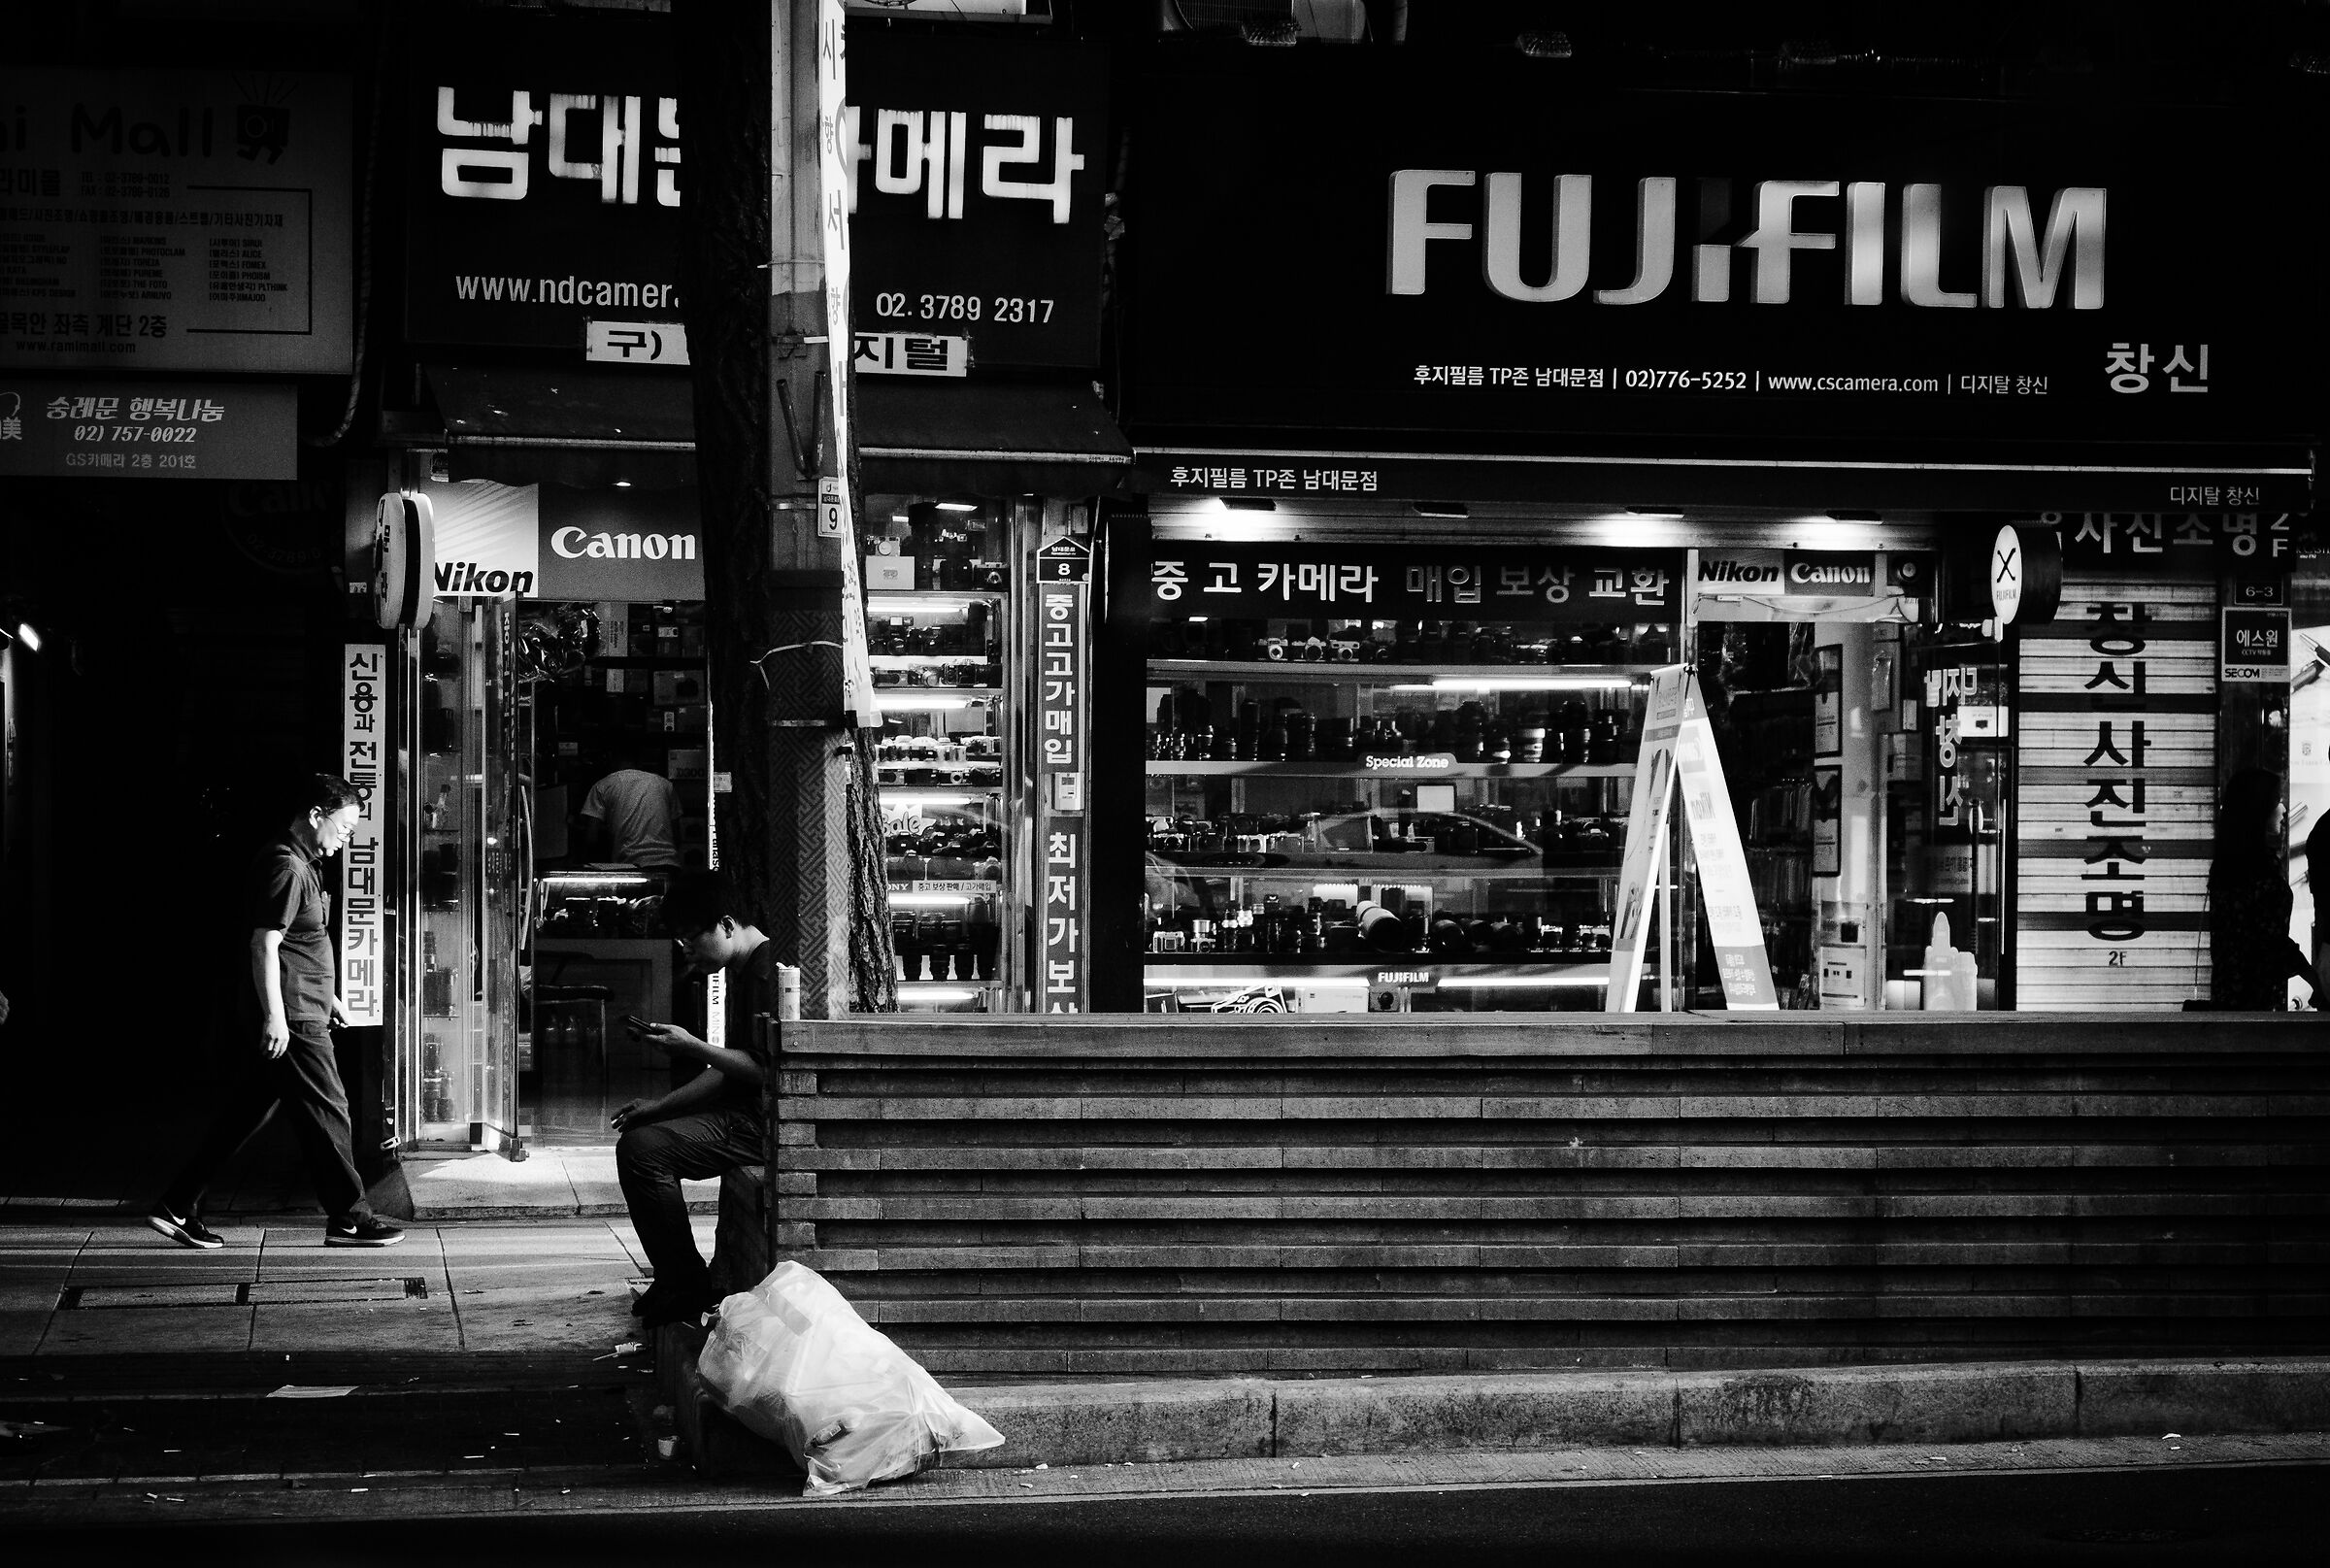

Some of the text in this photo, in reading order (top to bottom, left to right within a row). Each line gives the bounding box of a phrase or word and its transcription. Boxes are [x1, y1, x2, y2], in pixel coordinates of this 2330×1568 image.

[71, 103, 213, 157] Mall
[1386, 168, 2109, 311] FUJIFILM
[993, 297, 1054, 324] 2317
[53, 313, 90, 338] 좌측
[97, 314, 133, 337] 계단
[139, 316, 167, 338] 2층
[16, 341, 136, 353] www.ramimall.com
[2105, 342, 2210, 393] 창신
[1414, 365, 1484, 387] 후지필름
[1490, 366, 1528, 387] TP존
[1535, 367, 1604, 389] 남대문점
[1625, 369, 1747, 391] 02)776-5252
[1768, 374, 1939, 393] www.cscamera.com
[1961, 376, 2011, 395] 디지탈
[2016, 376, 2048, 396] 창신
[129, 396, 225, 421] 행복나눔
[74, 425, 197, 443] 02) 757-0022
[66, 453, 197, 469] GS카메라 2층 201호
[1170, 466, 1379, 491] 후지필름 TP존 남대문점
[2170, 487, 2260, 506] 디지탈 창신
[828, 507, 838, 531] 9
[433, 525, 696, 593] Nikon Canon
[1057, 562, 1071, 576] 8
[1257, 561, 1379, 603] 카메라
[1405, 564, 1481, 604] 매입
[1496, 565, 1575, 603] 보상
[1588, 567, 1670, 606] 교환
[1697, 560, 1871, 585] Nikon Canon
[2246, 586, 2274, 597] 6-3
[2237, 629, 2279, 648] 에스원
[2224, 668, 2260, 678] SECOM
[350, 652, 379, 734] 신용과
[1365, 754, 1449, 770] Special Zone
[2108, 951, 2127, 966] 2F
[1377, 971, 1430, 984] FUJIFILM
